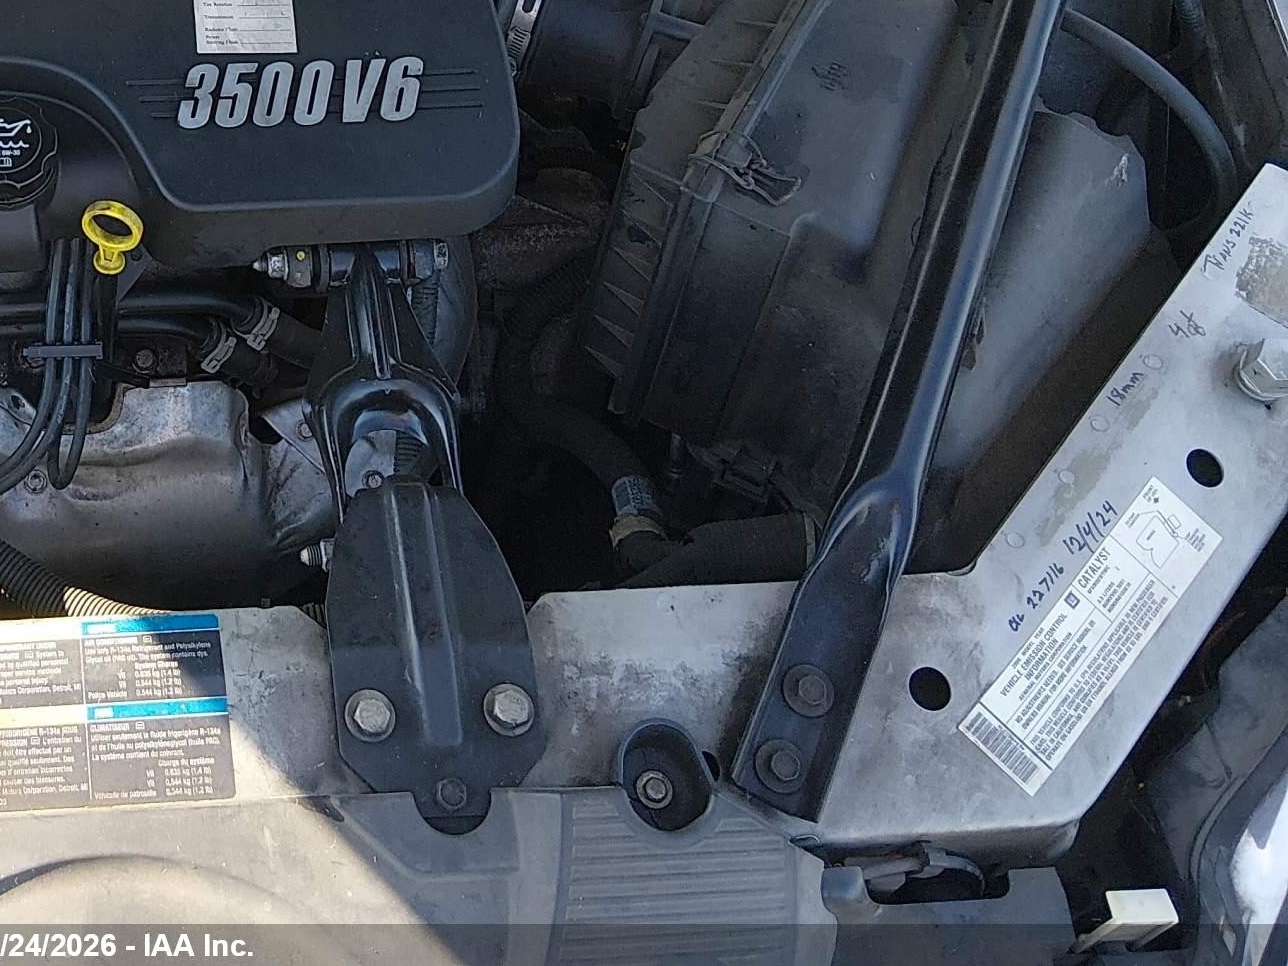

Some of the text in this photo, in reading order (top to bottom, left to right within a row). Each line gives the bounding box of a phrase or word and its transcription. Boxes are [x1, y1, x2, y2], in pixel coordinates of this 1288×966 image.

[1107, 371, 1144, 407] 18mm
[1063, 500, 1119, 556] 12/4/24
[1075, 546, 1112, 589] CATALYST
[1127, 578, 1156, 614] NEW PASSENGER
[83, 636, 138, 647] AIR CONDITIONER
[84, 647, 96, 655] Use
[96, 646, 109, 655] only
[131, 643, 163, 652] Refrigerant
[176, 641, 211, 650] Polyalkylene
[85, 655, 103, 666] Glycol
[103, 655, 111, 663] oil
[137, 652, 149, 661] The
[149, 651, 171, 661] system
[171, 649, 196, 659] contains
[998, 668, 1024, 698] VEHICLE
[1019, 638, 1047, 671] EMISSION
[1041, 610, 1068, 642] CONTROL
[1022, 636, 1059, 682] INFORMATION
[14, 659, 40, 668] qualified
[40, 657, 69, 667] personnel
[133, 659, 178, 671] System Charge
[1017, 630, 1073, 702] GENERAL MOTORS CORPORATION
[14, 667, 36, 677] service
[36, 666, 62, 675] methods
[1019, 685, 1045, 718] ADJUSTMENTS
[1062, 641, 1078, 661] SERVICE
[1074, 624, 1091, 645] MANUAL
[5, 677, 30, 686] personal
[16, 684, 51, 695] Corporation,
[87, 691, 105, 700] Police
[106, 689, 127, 699] Vehicle
[1034, 670, 1067, 712] MANUAL FOR MORE
[1078, 679, 1097, 704] QUALIFIES
[38, 725, 61, 735] R-134a
[89, 721, 130, 733] CLIMATISEUR
[111, 731, 143, 741] seulement
[200, 727, 221, 735] R-134a
[1044, 739, 1062, 762] OPERATE
[1064, 711, 1083, 734] GASOLINE
[42, 735, 73, 745] L'entretien
[2, 748, 14, 757] doit
[52, 746, 63, 755] par
[125, 750, 150, 759] contient
[62, 754, 75, 763] Des
[157, 758, 180, 767] Charge
[40, 764, 73, 774] incorrectes
[2, 777, 22, 786] causer
[35, 775, 65, 784] blessures.
[2, 786, 22, 796] Motors
[128, 788, 157, 798] patrouille
